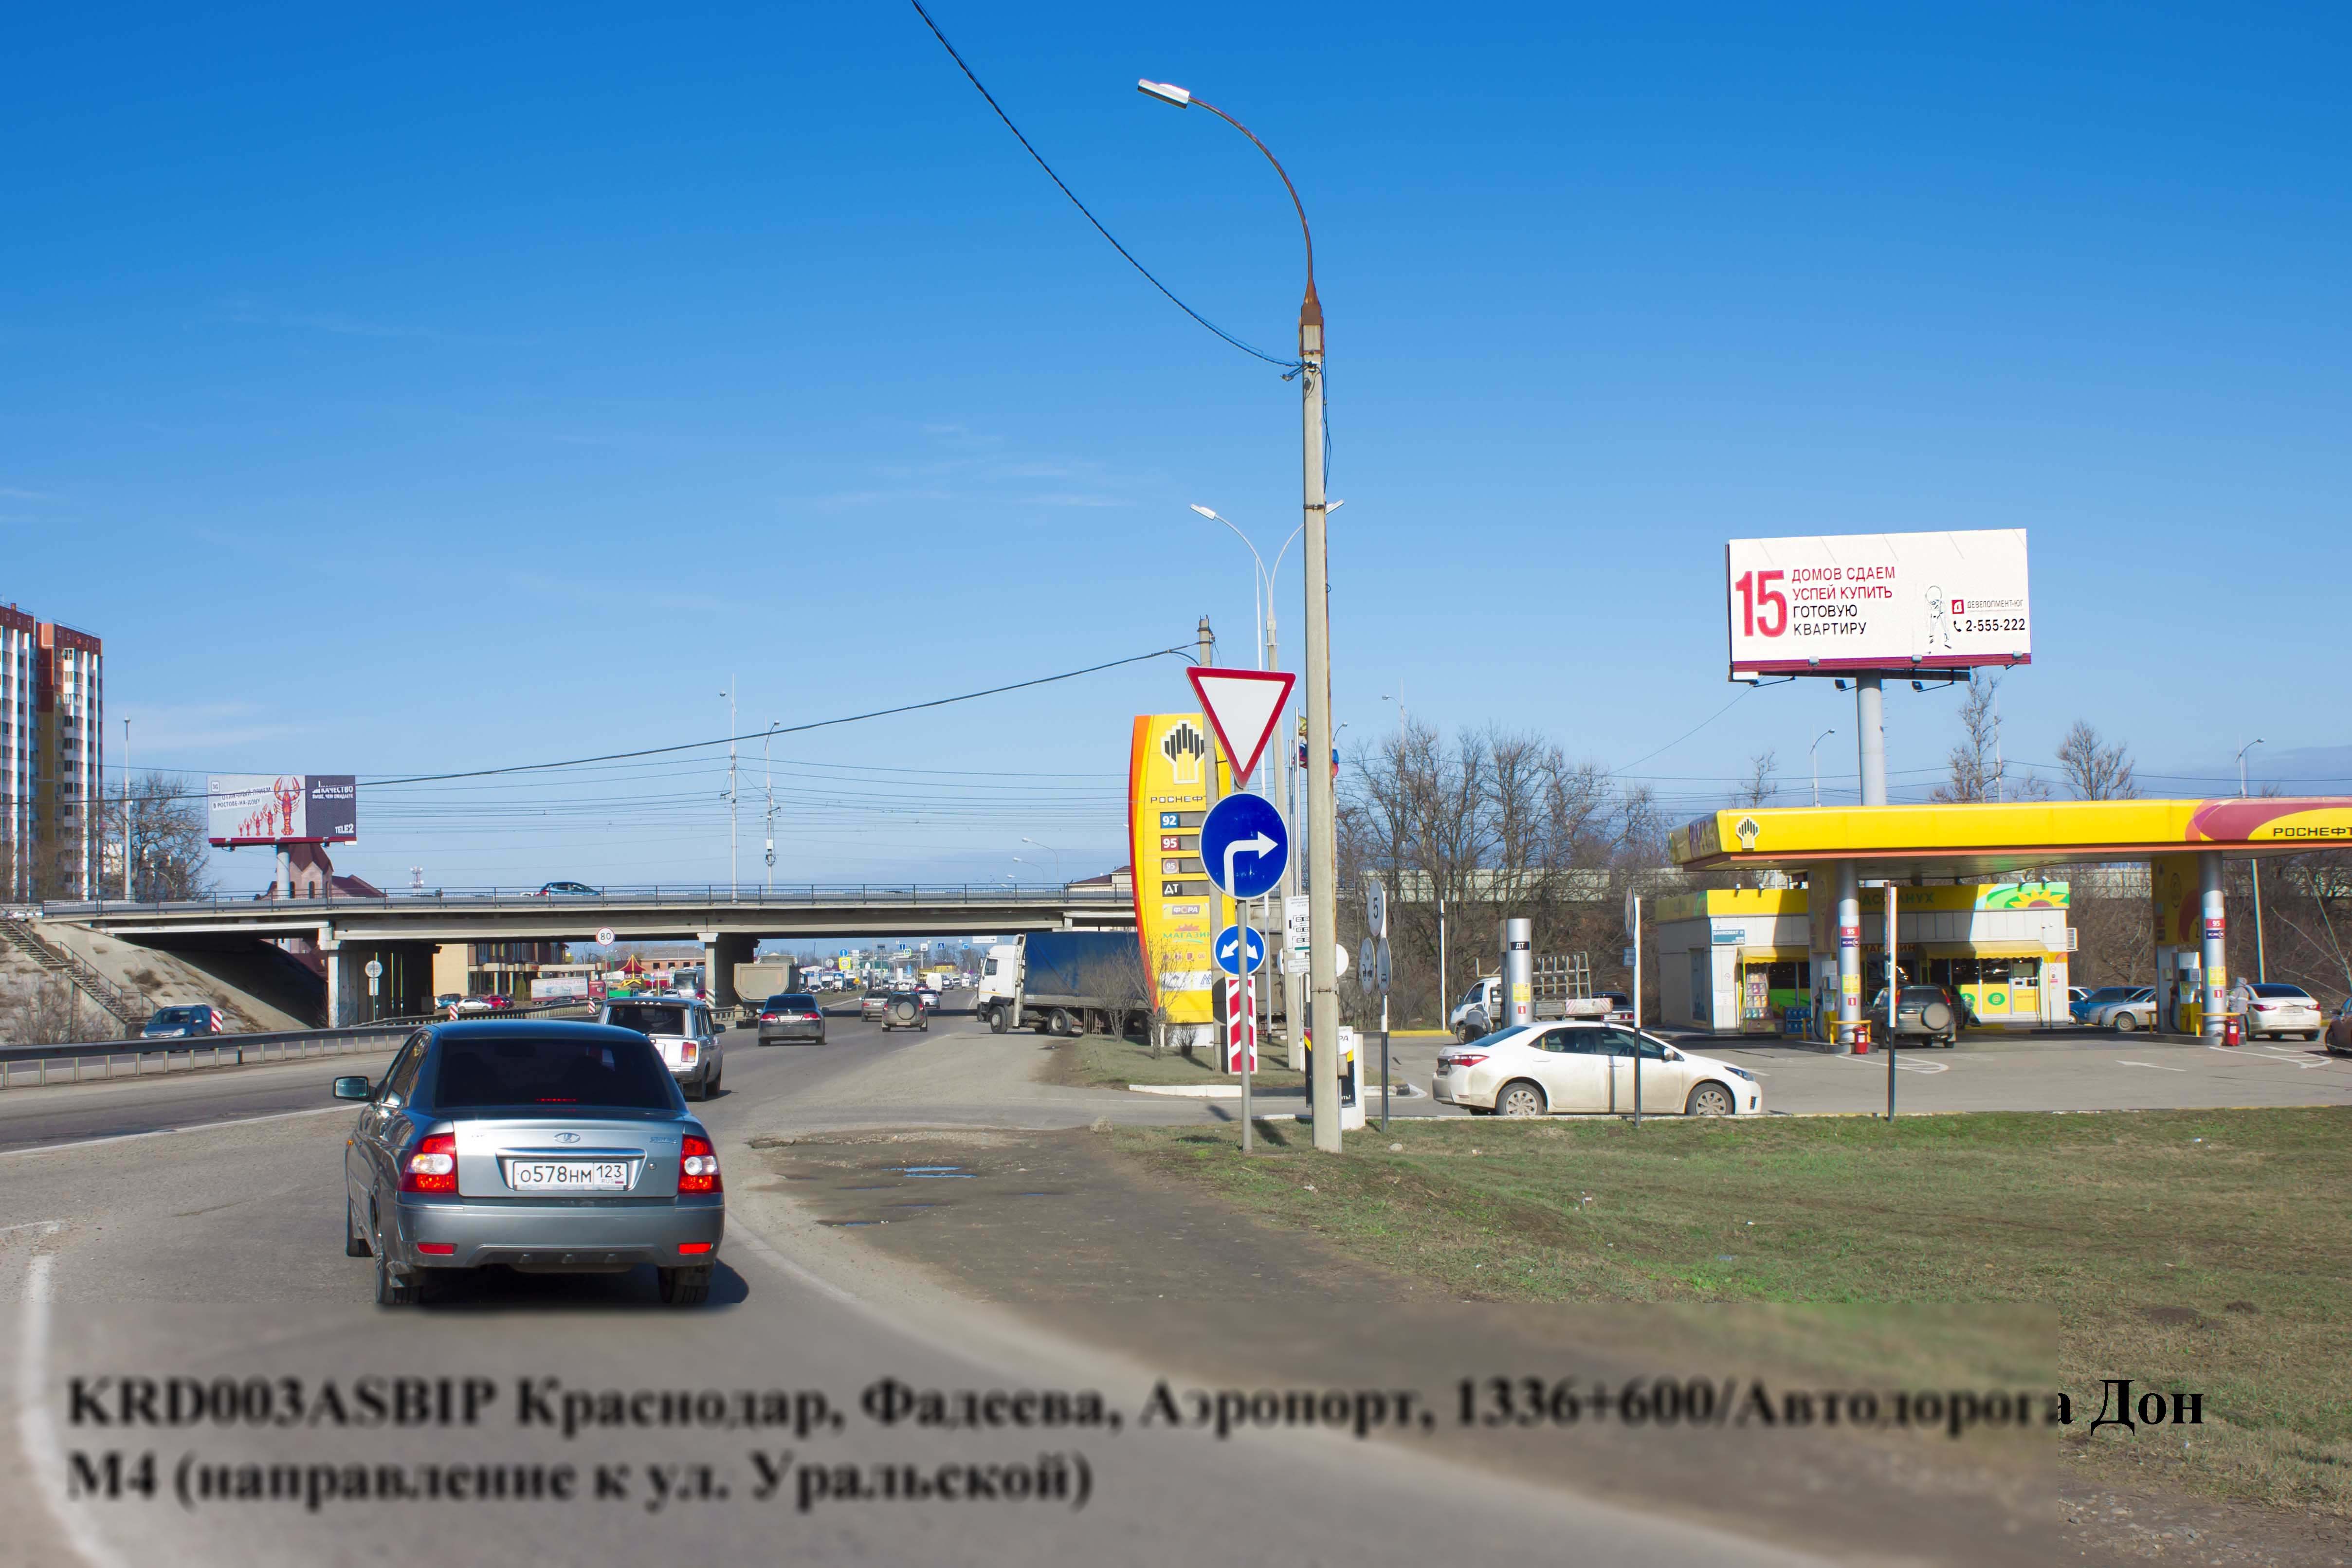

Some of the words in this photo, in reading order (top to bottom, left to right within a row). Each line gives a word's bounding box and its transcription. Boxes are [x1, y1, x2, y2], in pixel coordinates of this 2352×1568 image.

[1792, 568, 1842, 583] ДОМОВ
[1846, 566, 1895, 582] СДАЕМ
[1792, 584, 1836, 601] УСПЕЙ
[1841, 586, 1893, 600] КУПИТЬ
[1735, 570, 1787, 638] 15
[1793, 604, 1857, 618] ГОТОВУЮ
[1967, 600, 2024, 608] ДЕВЕЛОПМЕНТ-ЮГ
[1794, 621, 1867, 636] КВАРТИРУ
[1966, 618, 2025, 632] 2-555-222
[1162, 815, 1177, 826] 92
[335, 823, 354, 834] TELE2
[1163, 838, 1177, 848] 95
[1164, 884, 1179, 895] ДТ
[1373, 897, 1379, 919] 5
[596, 1165, 622, 1178] 123
